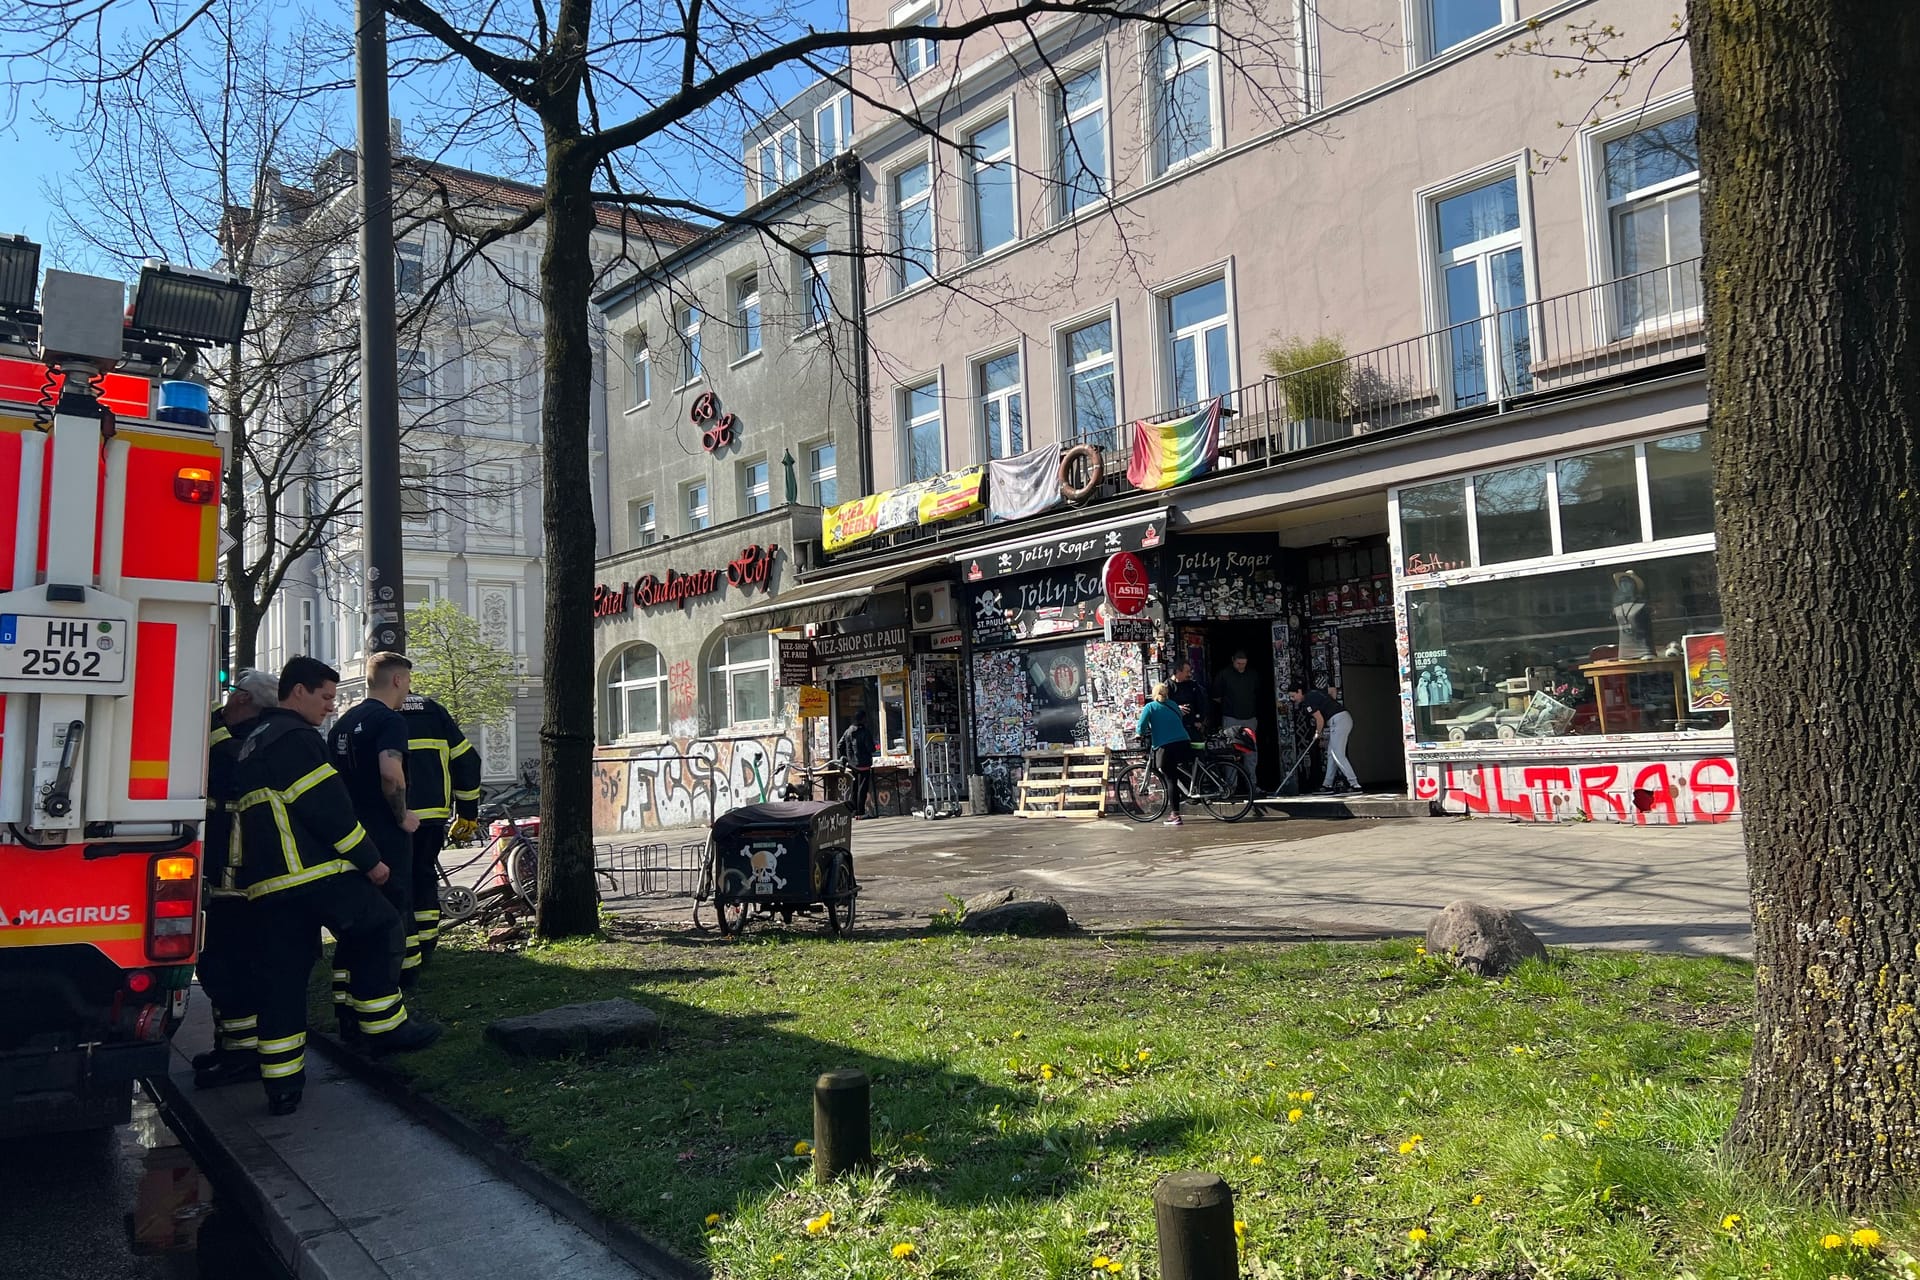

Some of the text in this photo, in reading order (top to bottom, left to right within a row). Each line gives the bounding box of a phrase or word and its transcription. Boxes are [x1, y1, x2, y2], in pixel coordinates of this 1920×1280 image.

[1016, 539, 1097, 570] Jolly Roger
[1173, 552, 1272, 578] Jolly Roger
[633, 568, 722, 610] Budapester
[727, 543, 778, 594] Hof
[1014, 577, 1067, 621] Jolly
[1118, 586, 1144, 595] ASTRA
[4, 633, 12, 641] D
[47, 621, 88, 648] HH
[815, 636, 861, 656] KIEZ-SHOP
[863, 632, 876, 649] ST.
[877, 628, 906, 647] PAULI
[22, 649, 101, 677] 2562
[1414, 649, 1447, 659] COCOROSIE
[1446, 757, 1735, 826] ULTRAS
[20, 905, 131, 926] MAGIRUS
